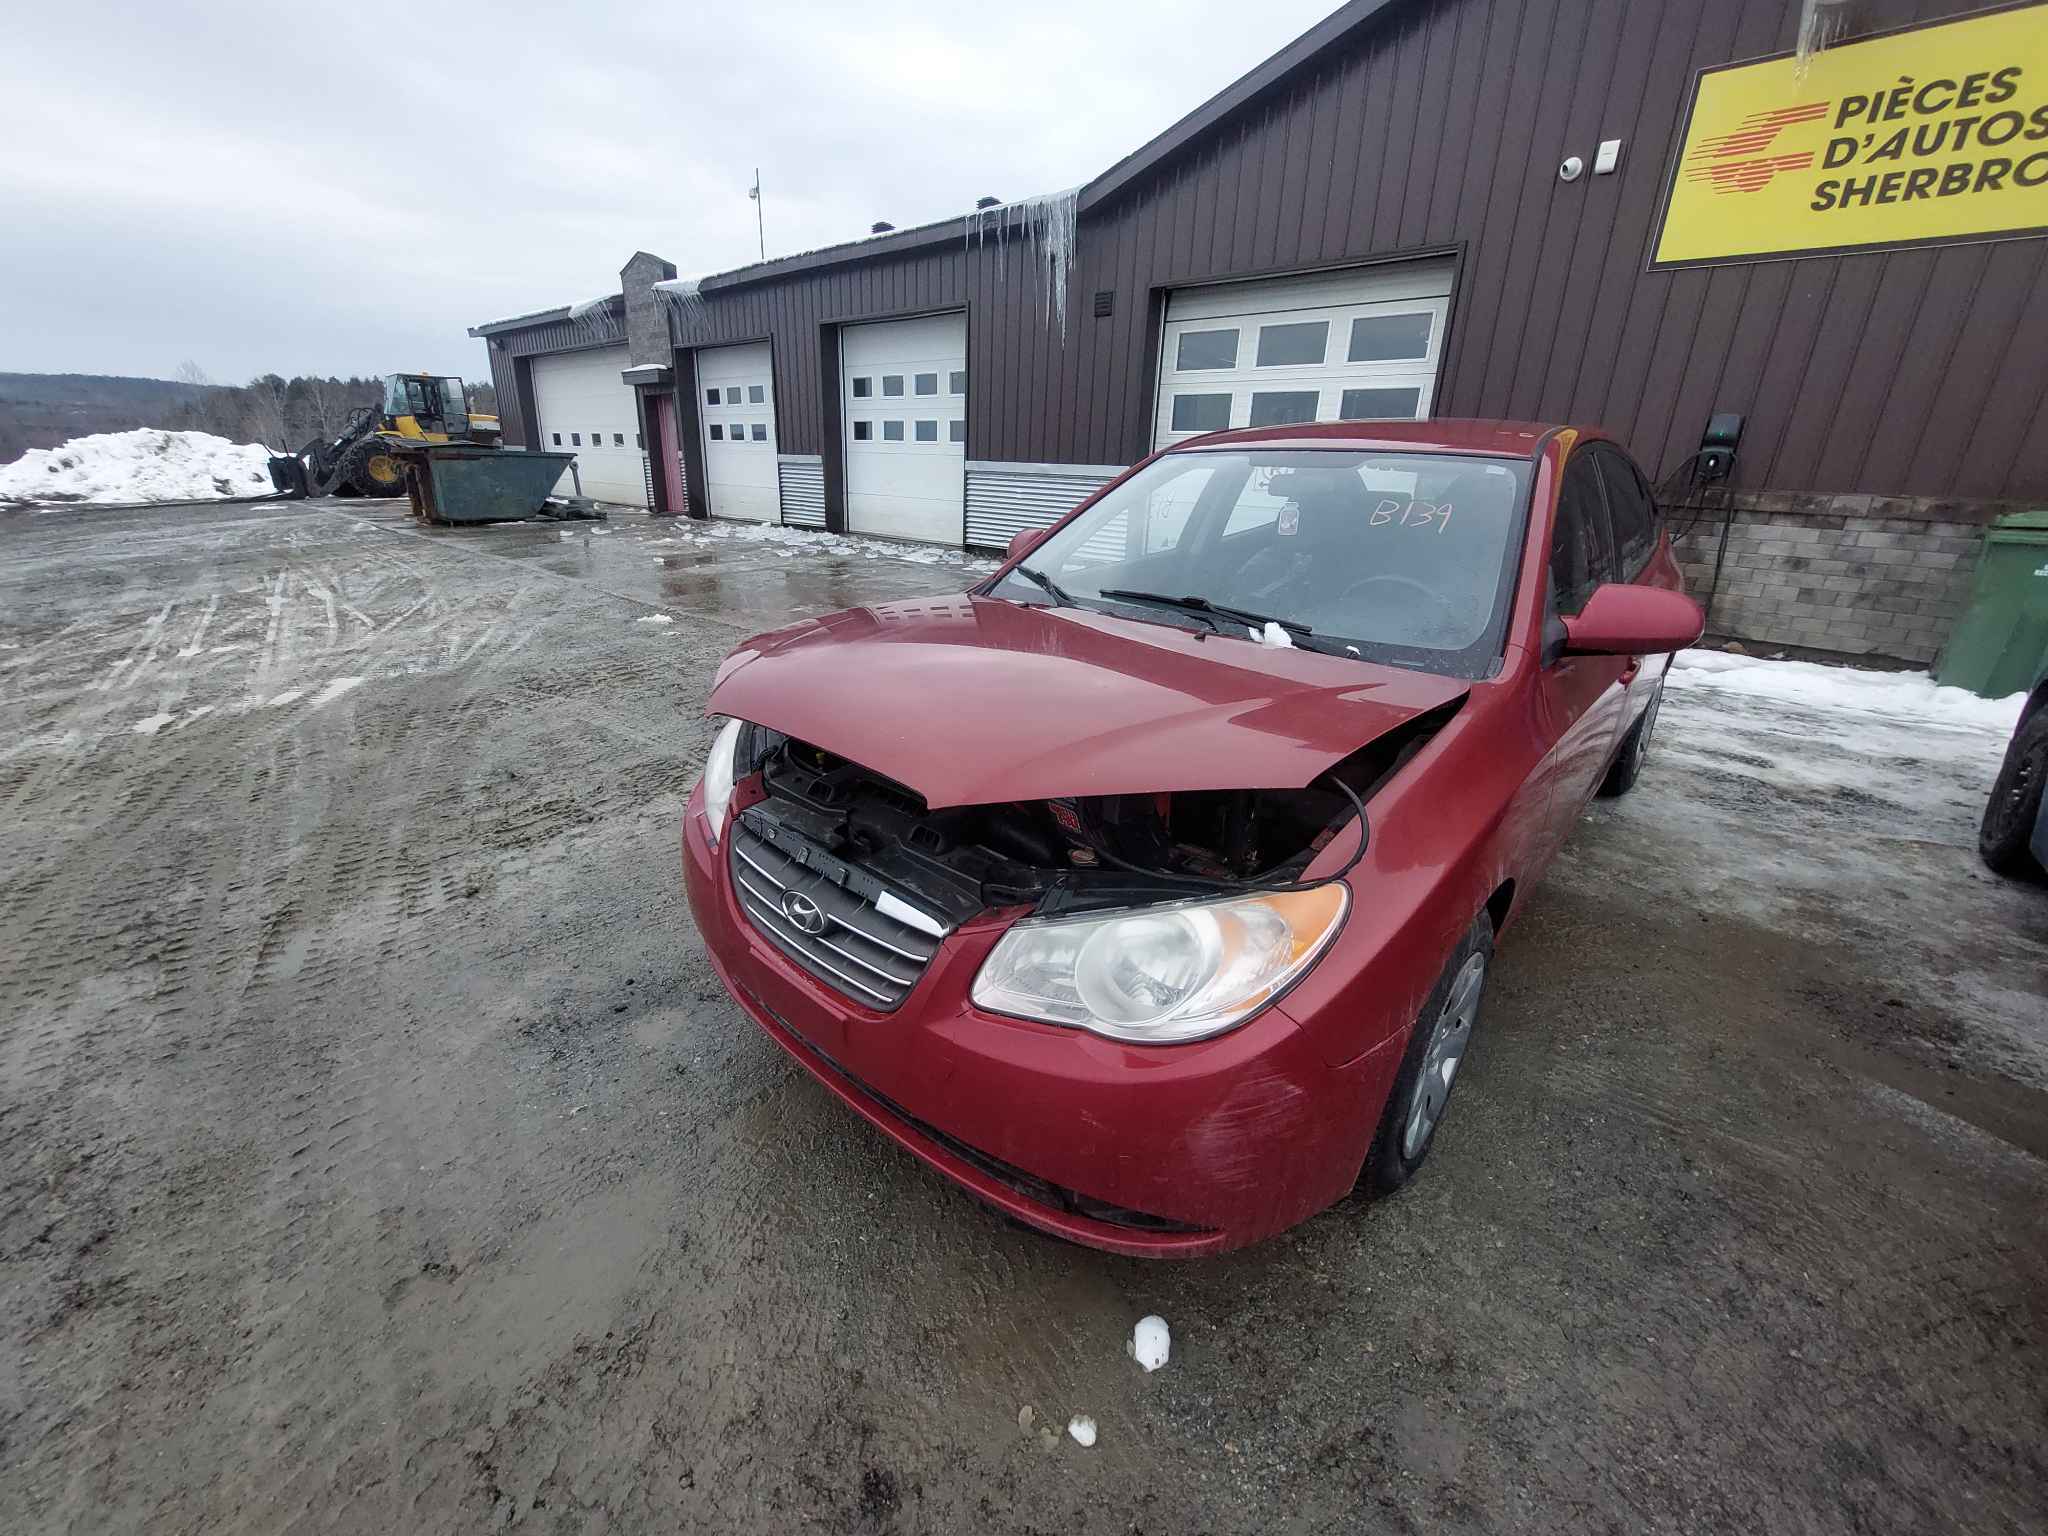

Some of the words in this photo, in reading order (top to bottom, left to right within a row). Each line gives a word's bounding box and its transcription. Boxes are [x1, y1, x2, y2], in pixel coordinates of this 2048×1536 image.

[1834, 66, 2022, 129] PIÈCES
[1822, 104, 2048, 169] D'AUTOS
[1810, 151, 2048, 212] SHERBRO
